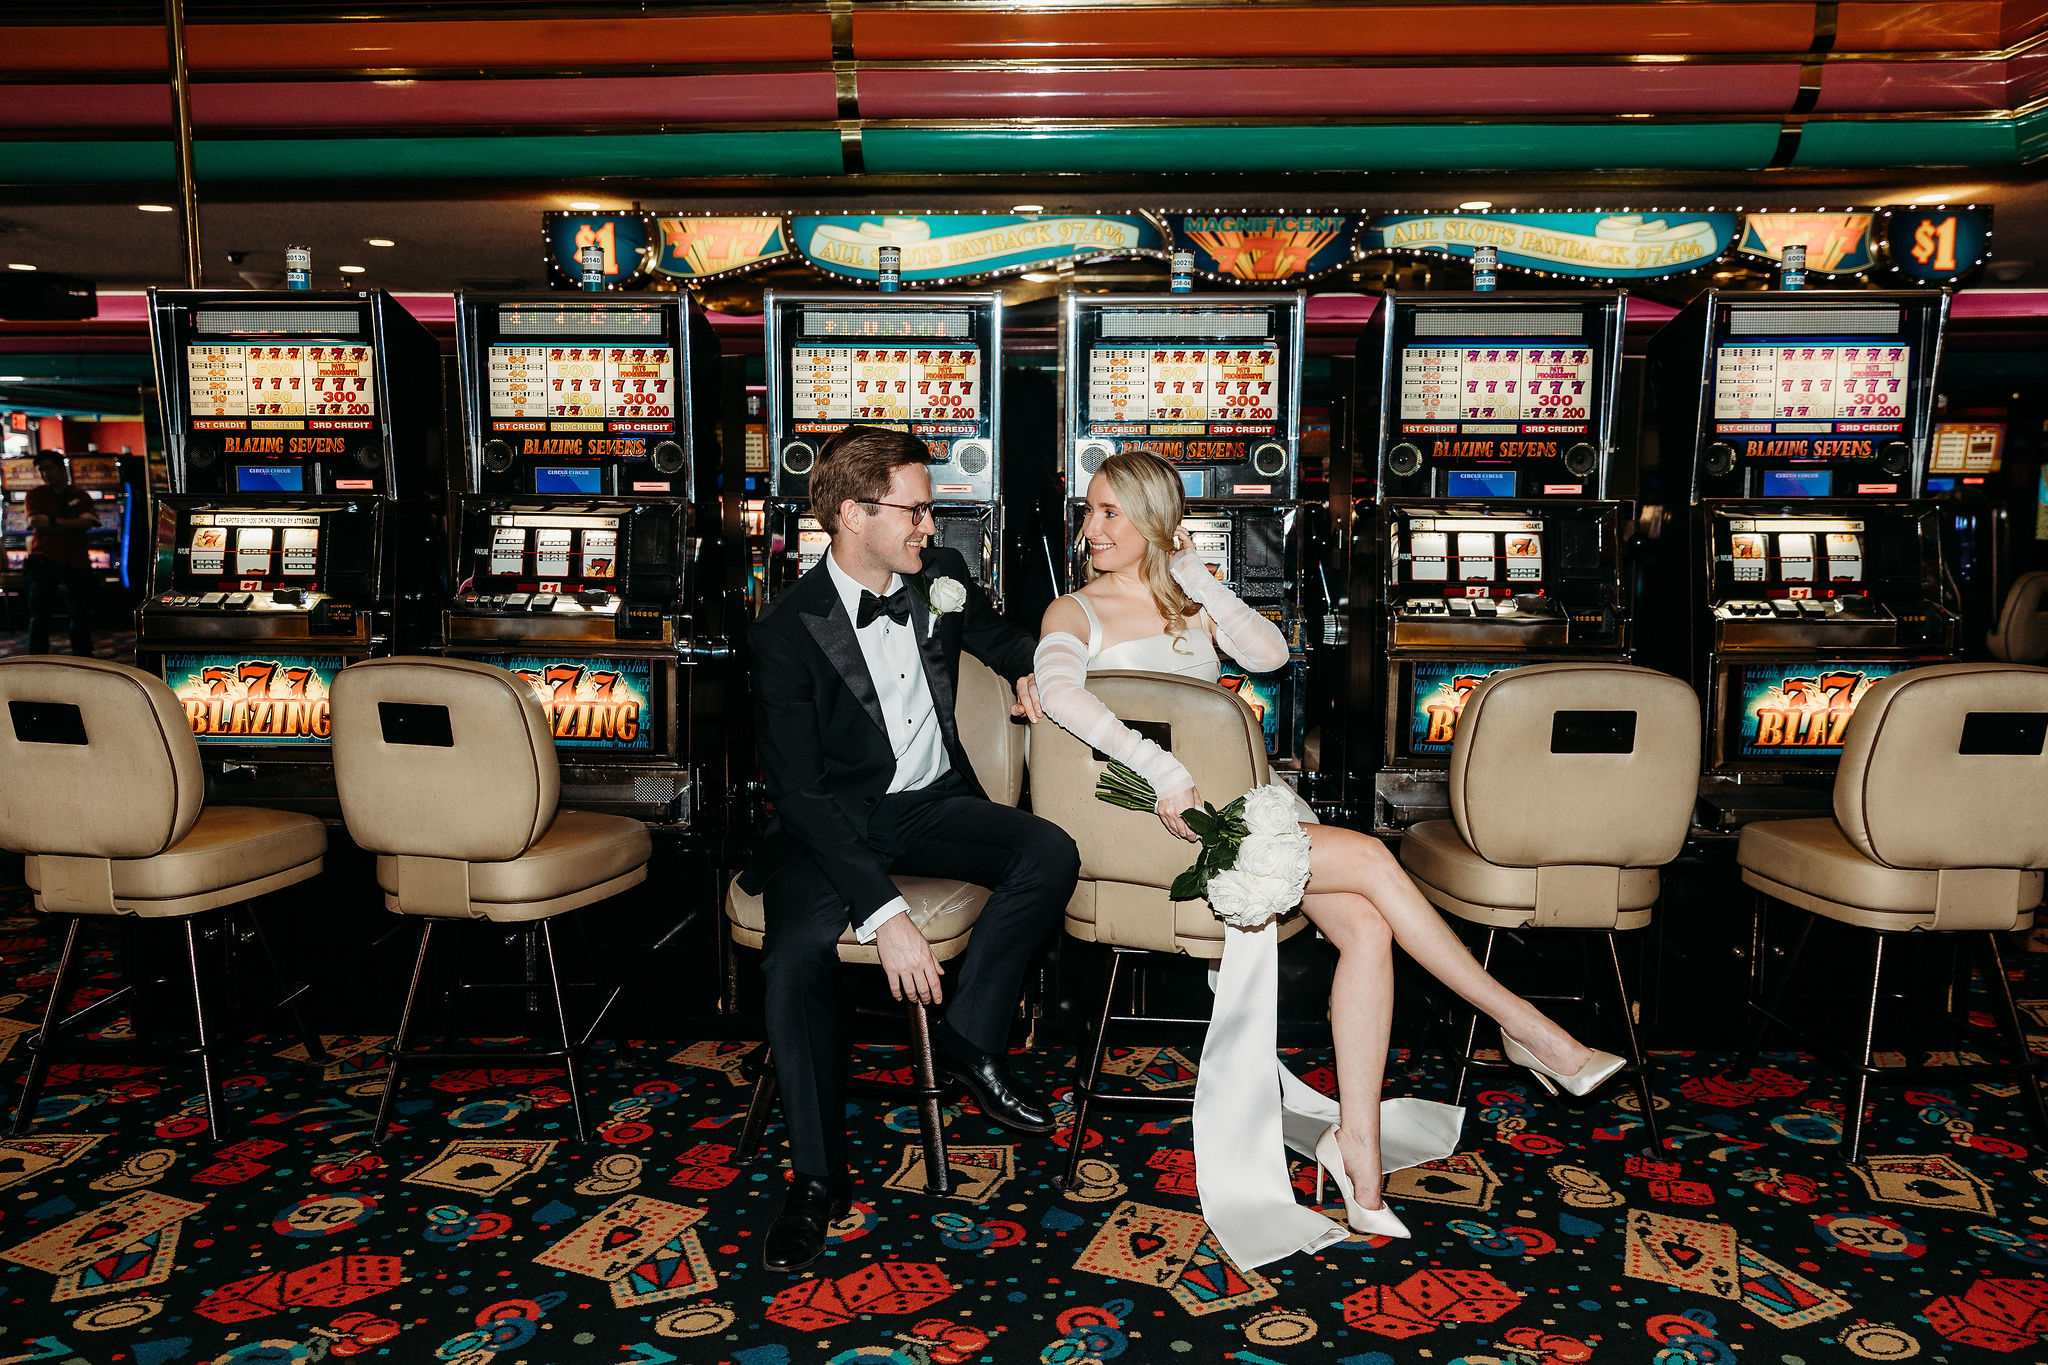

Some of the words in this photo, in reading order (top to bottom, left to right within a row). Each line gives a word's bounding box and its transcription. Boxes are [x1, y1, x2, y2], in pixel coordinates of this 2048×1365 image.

[1184, 217, 1345, 233] MAGNIFICENT
[573, 222, 619, 275] $1
[819, 241, 864, 266] ALL
[870, 243, 941, 267] SOTS
[948, 224, 1051, 261] PAYBACK
[1058, 221, 1125, 245] 97.4%
[1393, 220, 1438, 245] ALL
[1443, 220, 1515, 245] SLOTS
[1520, 231, 1629, 265] PAYBACK
[1635, 240, 1703, 267] 97.4%
[1910, 216, 1957, 271] $1
[207, 354, 226, 362] 60
[508, 355, 527, 364] 60
[812, 356, 831, 365] 60
[1109, 358, 1129, 366] 60
[207, 368, 227, 376] 40
[256, 363, 293, 376] 500
[508, 369, 527, 378] 40
[557, 364, 594, 378] 500
[812, 371, 831, 379] 40
[862, 365, 899, 379] 500
[1159, 366, 1197, 380] 500
[1109, 372, 1129, 380] 40
[208, 382, 227, 390] 20
[509, 383, 527, 391] 20
[552, 378, 564, 391] 7
[571, 379, 583, 391] 7
[589, 379, 602, 391] 7
[612, 379, 626, 393] 7
[633, 379, 647, 393] 7
[653, 379, 668, 393] 7
[812, 384, 831, 393] 20
[1109, 386, 1128, 394] 20
[211, 394, 227, 403] 10
[260, 390, 292, 403] 150
[322, 391, 357, 403] 300
[511, 396, 527, 404] 10
[561, 392, 592, 405] 150
[622, 393, 657, 405] 300
[814, 397, 830, 406] 10
[865, 394, 896, 406] 150
[927, 395, 962, 407] 300
[1111, 398, 1127, 407] 10
[1162, 394, 1194, 407] 150
[1225, 395, 1260, 407] 300
[1538, 394, 1573, 407] 300
[1853, 393, 1889, 405] 300
[215, 407, 225, 415] 2
[283, 403, 304, 415] 100
[346, 403, 370, 415] 200
[514, 409, 524, 417] 2
[583, 405, 604, 416] 100
[646, 405, 670, 417] 200
[817, 410, 827, 418] 2
[887, 406, 908, 418] 100
[951, 407, 975, 419] 200
[1184, 407, 1206, 419] 100
[1249, 407, 1273, 419] 200
[1561, 407, 1586, 418] 200
[1876, 405, 1901, 417] 200
[1114, 412, 1124, 420] 2
[224, 437, 284, 454] BLAZING
[288, 436, 347, 454] SEVENS
[522, 438, 583, 455] BLAZING
[587, 438, 645, 456] SEVENS
[1187, 441, 1247, 459] SEVENS
[1432, 441, 1494, 458] BLAZING
[1499, 441, 1558, 458] SEVENS
[1745, 439, 1808, 457] BLAZING
[1813, 439, 1873, 457] SEVENS
[183, 698, 331, 739] BLAZING
[543, 701, 639, 740] ZING
[1754, 708, 1852, 746] BLAZ
